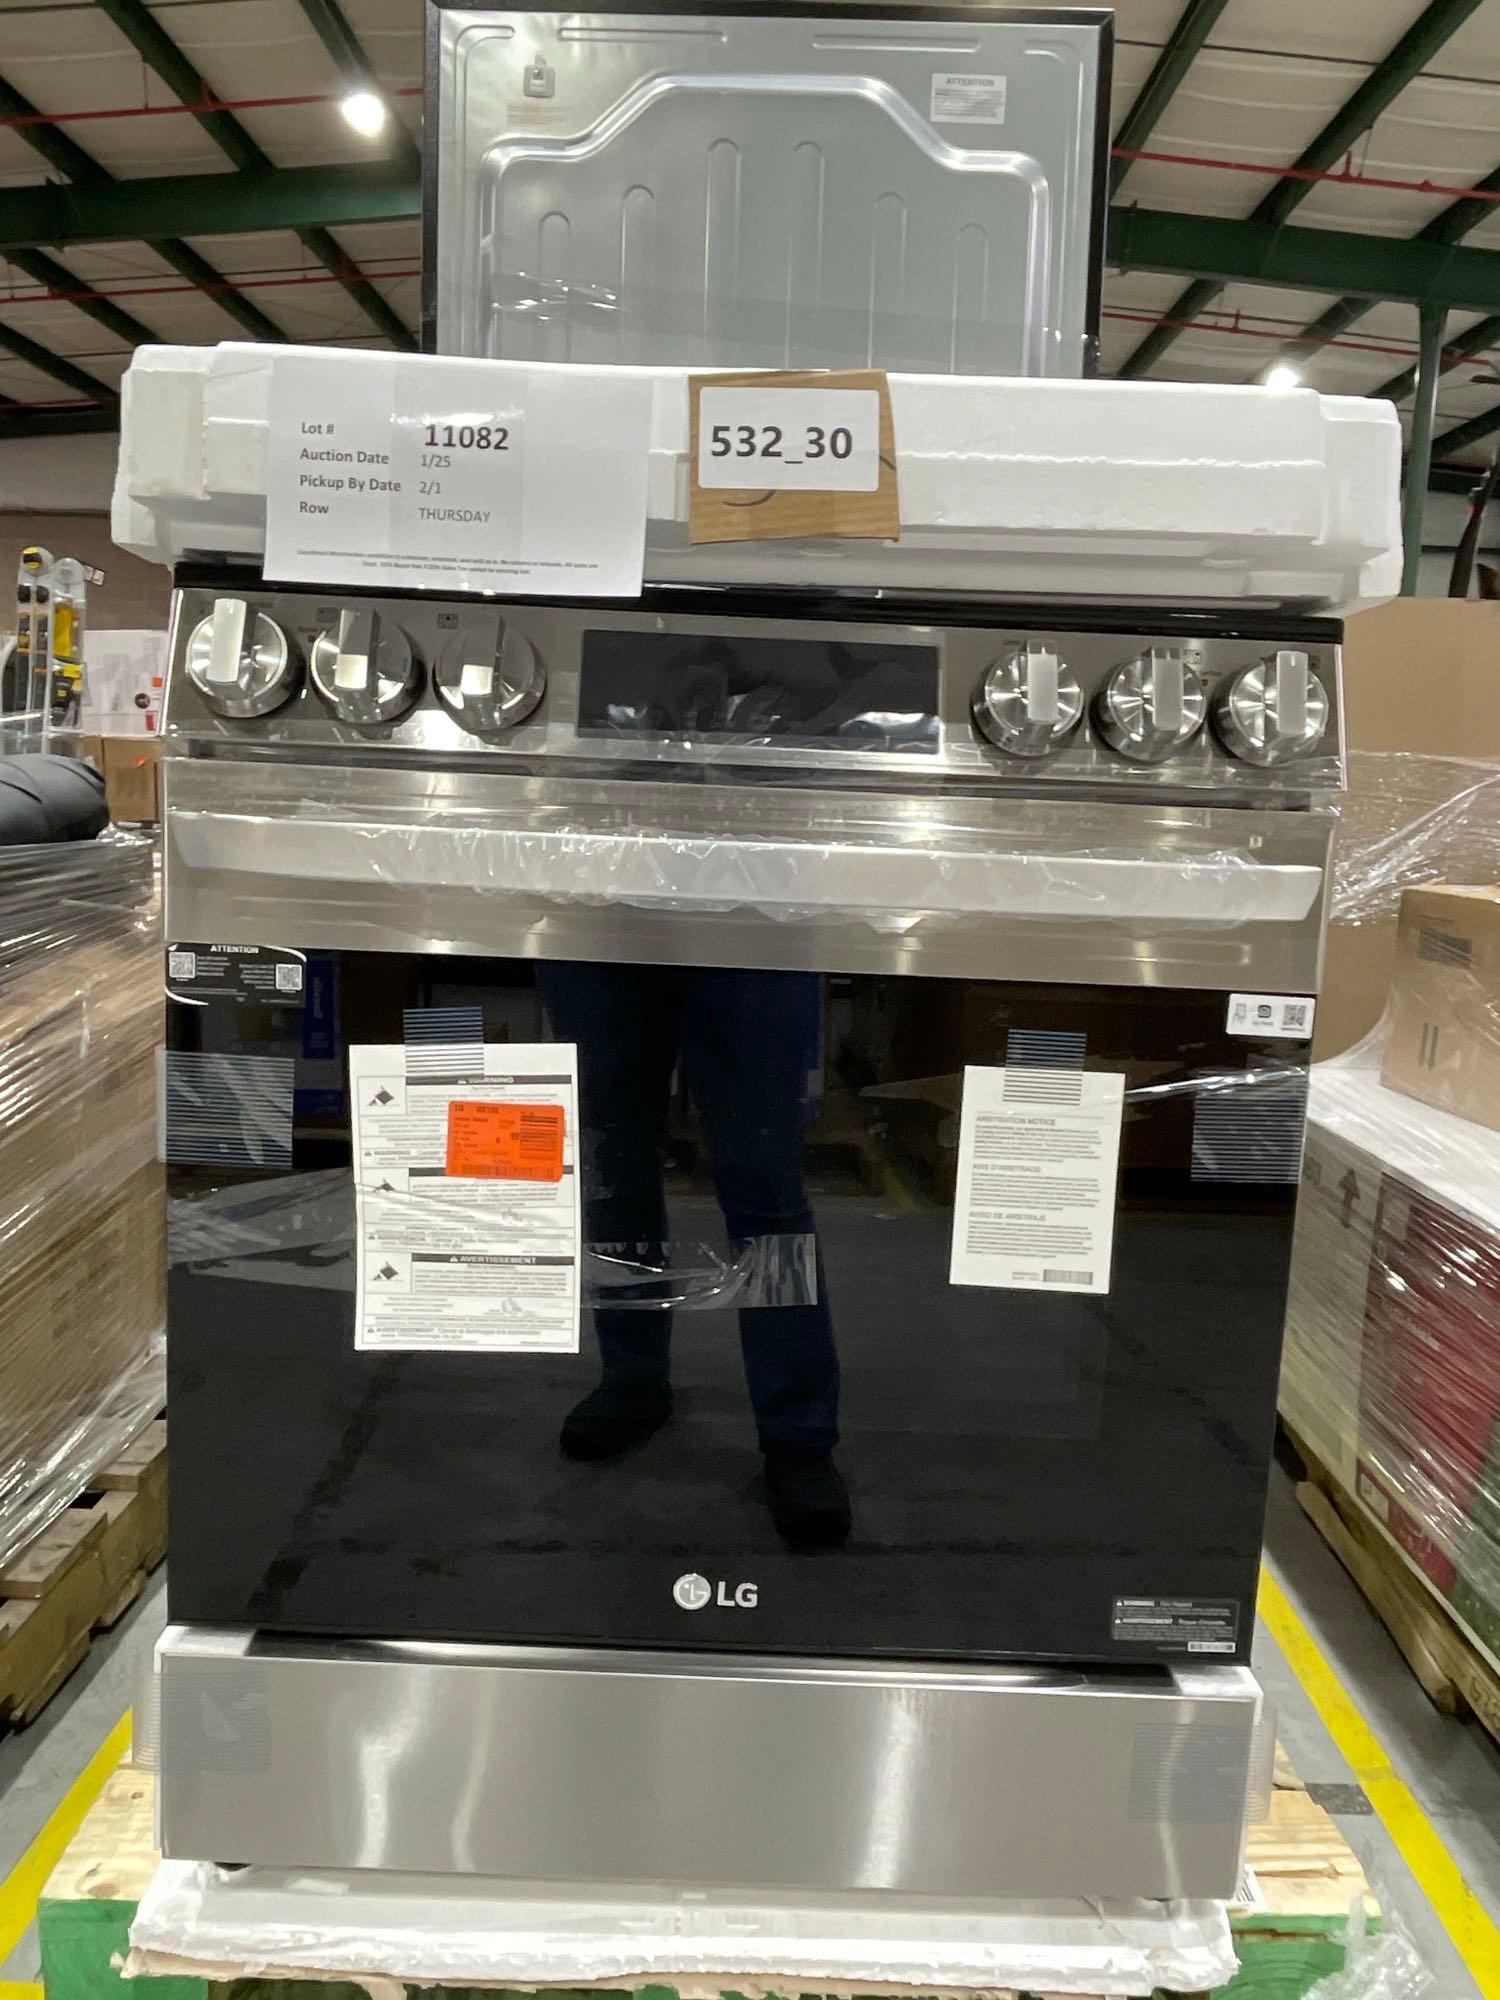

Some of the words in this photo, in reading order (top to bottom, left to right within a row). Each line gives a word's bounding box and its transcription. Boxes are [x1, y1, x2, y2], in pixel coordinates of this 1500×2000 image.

[301, 422, 323, 435] Lot
[326, 423, 335, 435] #
[425, 424, 509, 451] 11082
[711, 425, 853, 464] 532_30
[300, 448, 353, 463] Auction
[357, 451, 390, 465] Date
[420, 454, 451, 469] 1/25
[300, 474, 345, 491] Pickup
[348, 478, 366, 492] By
[369, 478, 402, 492] Date
[419, 481, 441, 496] 2/1
[300, 501, 330, 515] Row
[418, 507, 491, 523] THURSDAY
[210, 944, 259, 954] ATTENTION
[717, 1581, 758, 1608] LG
